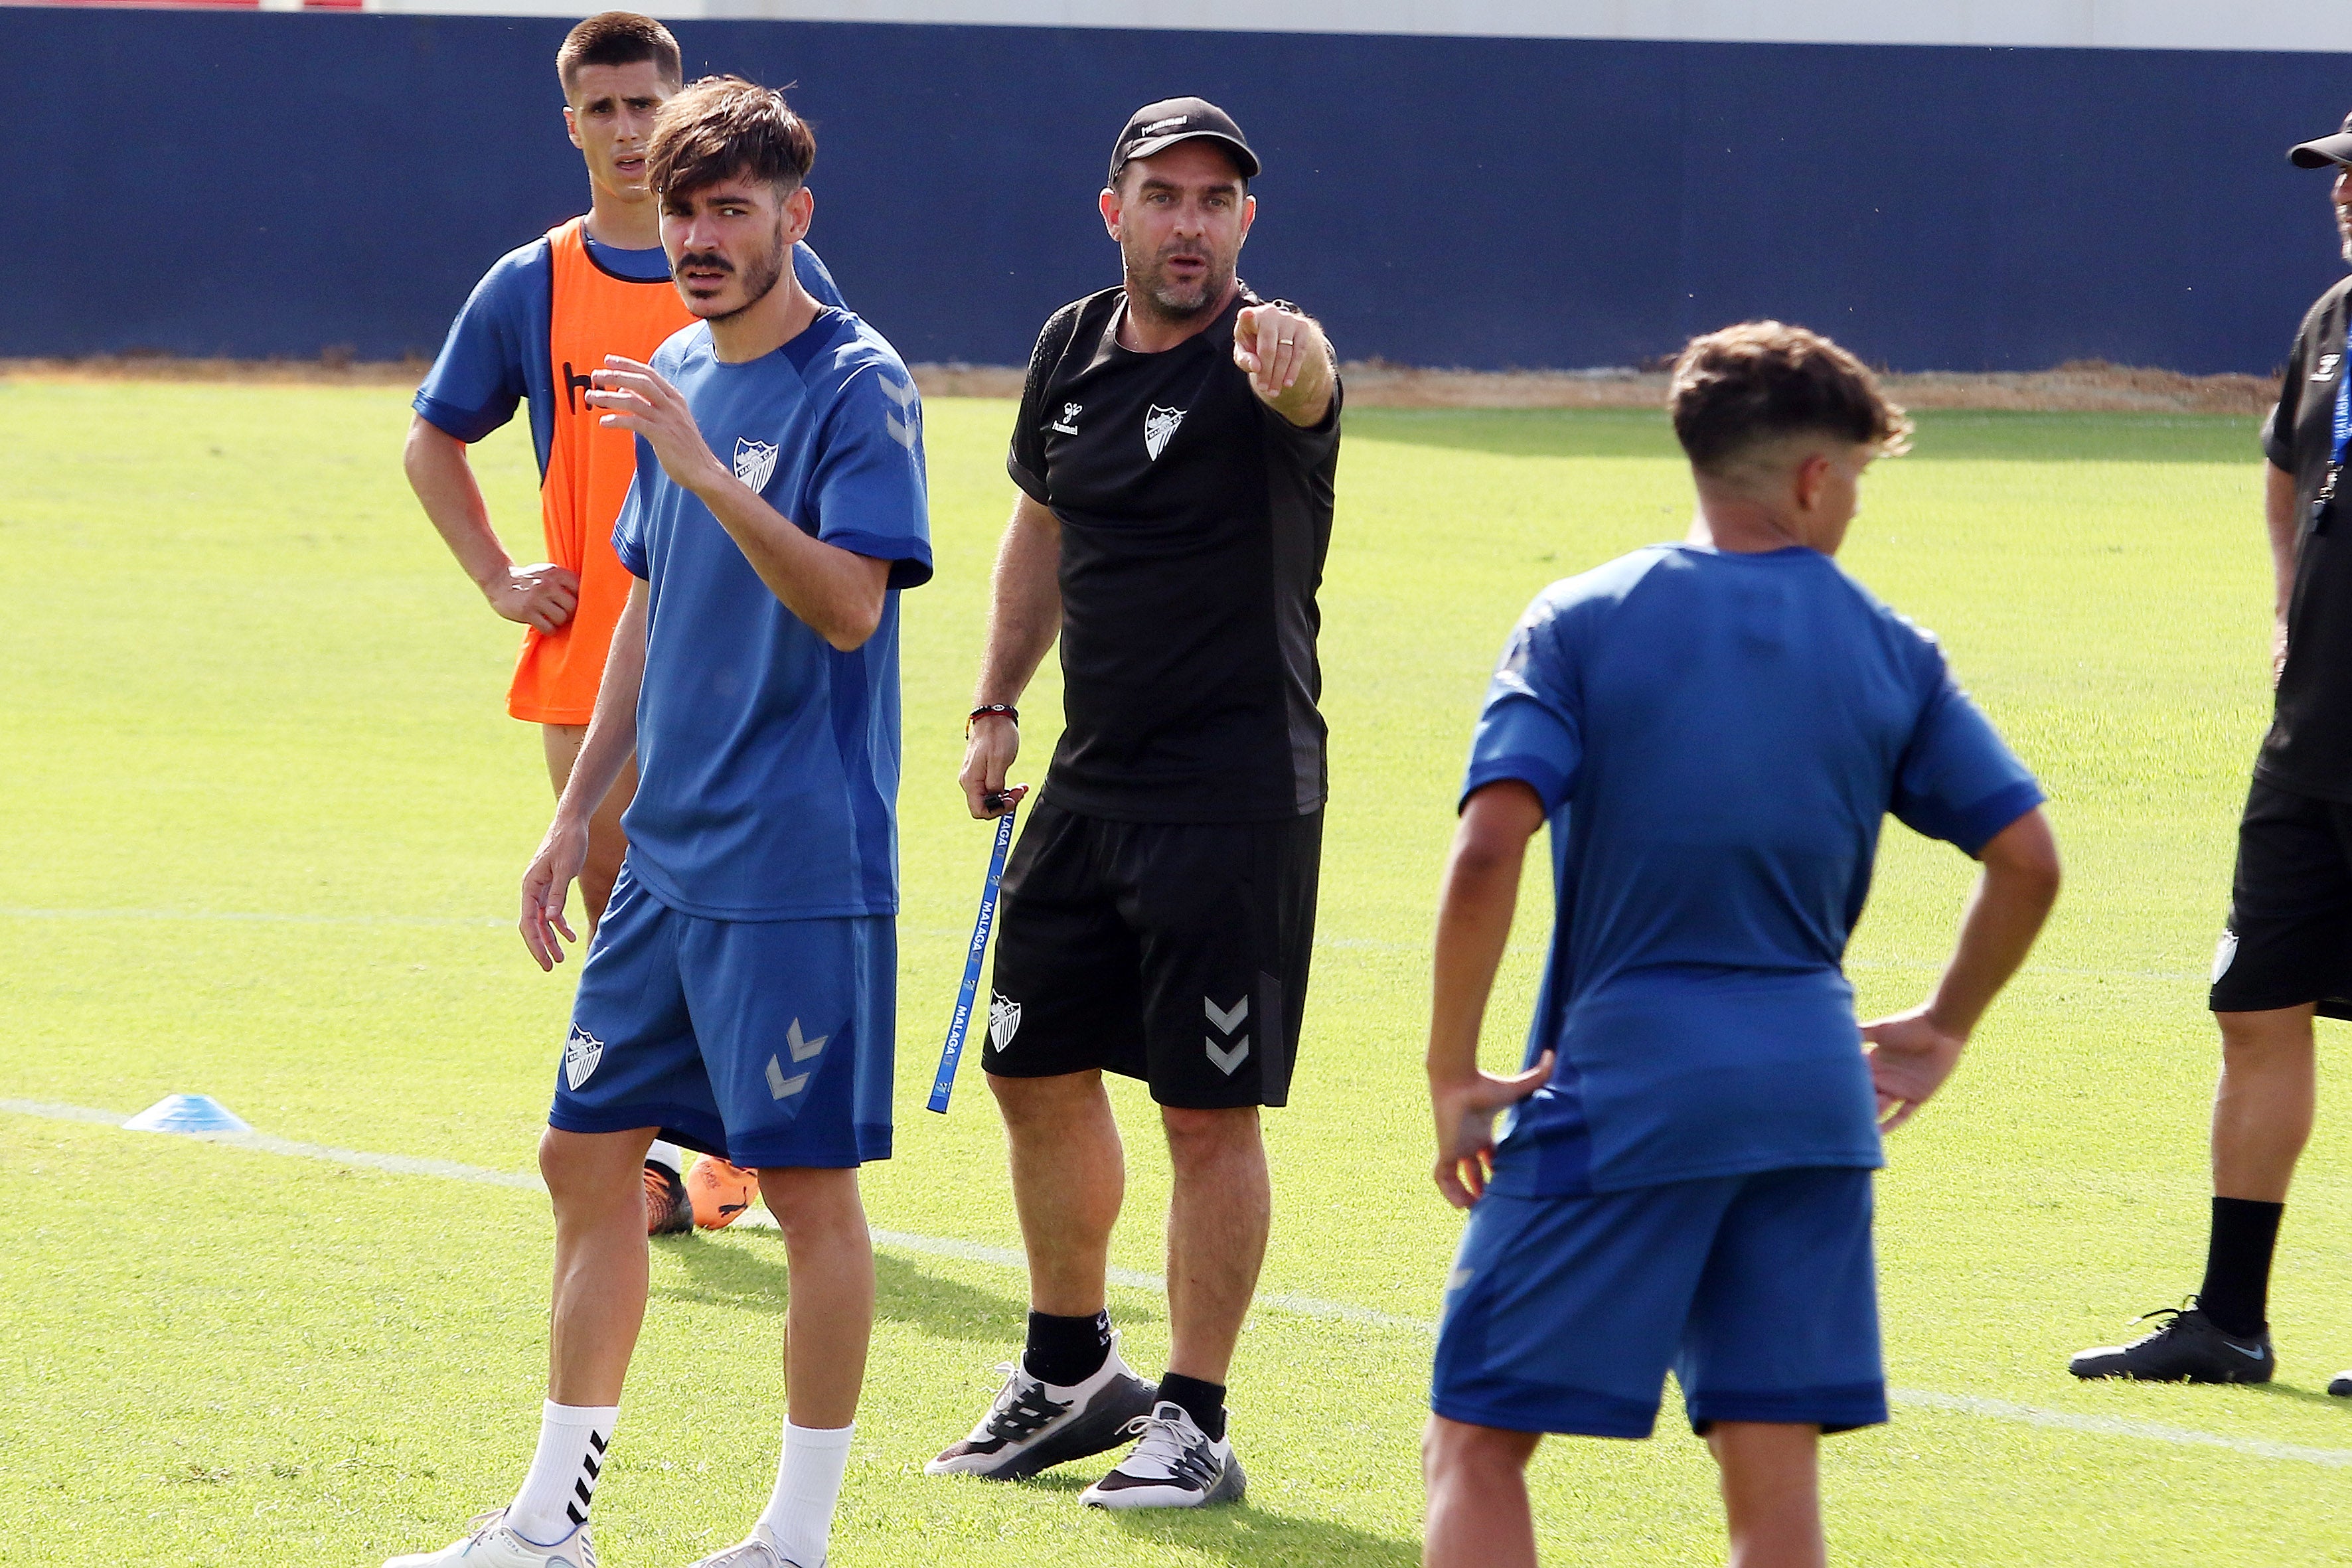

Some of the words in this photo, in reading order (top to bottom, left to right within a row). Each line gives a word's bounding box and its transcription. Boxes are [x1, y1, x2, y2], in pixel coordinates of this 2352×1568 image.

[1141, 115, 1188, 137] hummel
[972, 900, 993, 952] MALAGA
[945, 1004, 967, 1055] MALAGA
